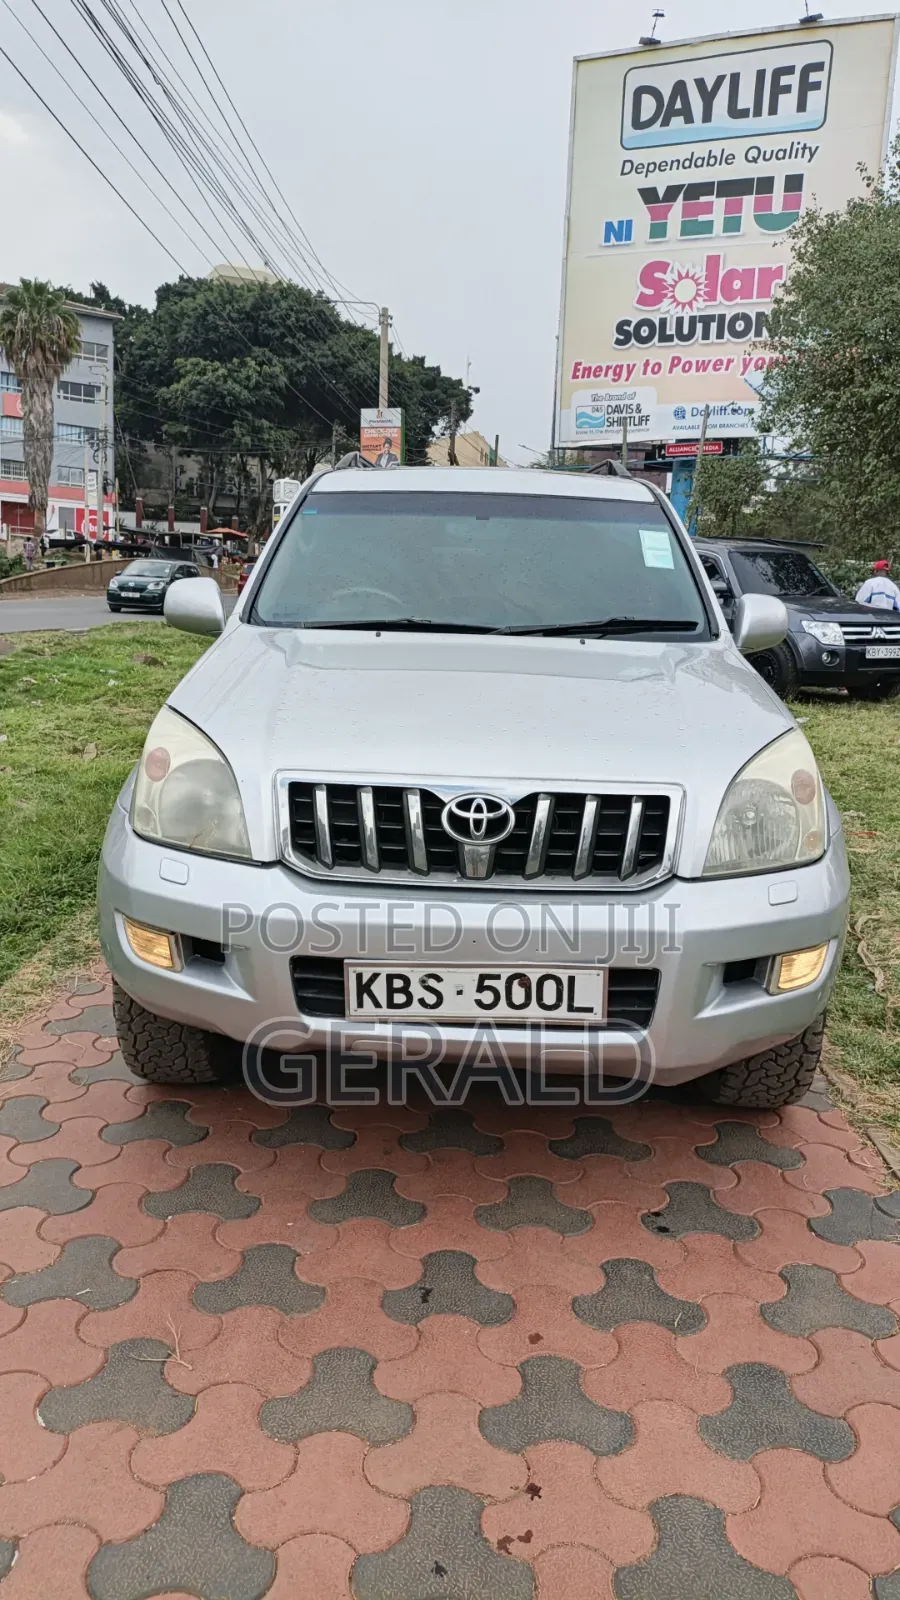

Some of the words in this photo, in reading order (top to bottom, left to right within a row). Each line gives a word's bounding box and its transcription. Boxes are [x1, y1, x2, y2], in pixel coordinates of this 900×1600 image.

[631, 61, 825, 130] DAYLIFF
[620, 149, 736, 178] Dependable
[744, 141, 820, 164] Quality
[604, 219, 633, 243] NI
[637, 173, 804, 240] YETU
[636, 254, 784, 312] Solar
[571, 361, 637, 383] Energy
[642, 359, 662, 376] to
[668, 355, 735, 375] Power
[591, 393, 604, 402] The
[604, 392, 627, 401] Brand
[627, 391, 636, 400] of
[606, 404, 634, 415] DAVIS
[635, 403, 642, 414] &
[867, 648, 881, 657] KBY
[355, 972, 444, 1010] KBS
[474, 972, 594, 1013] 500L
